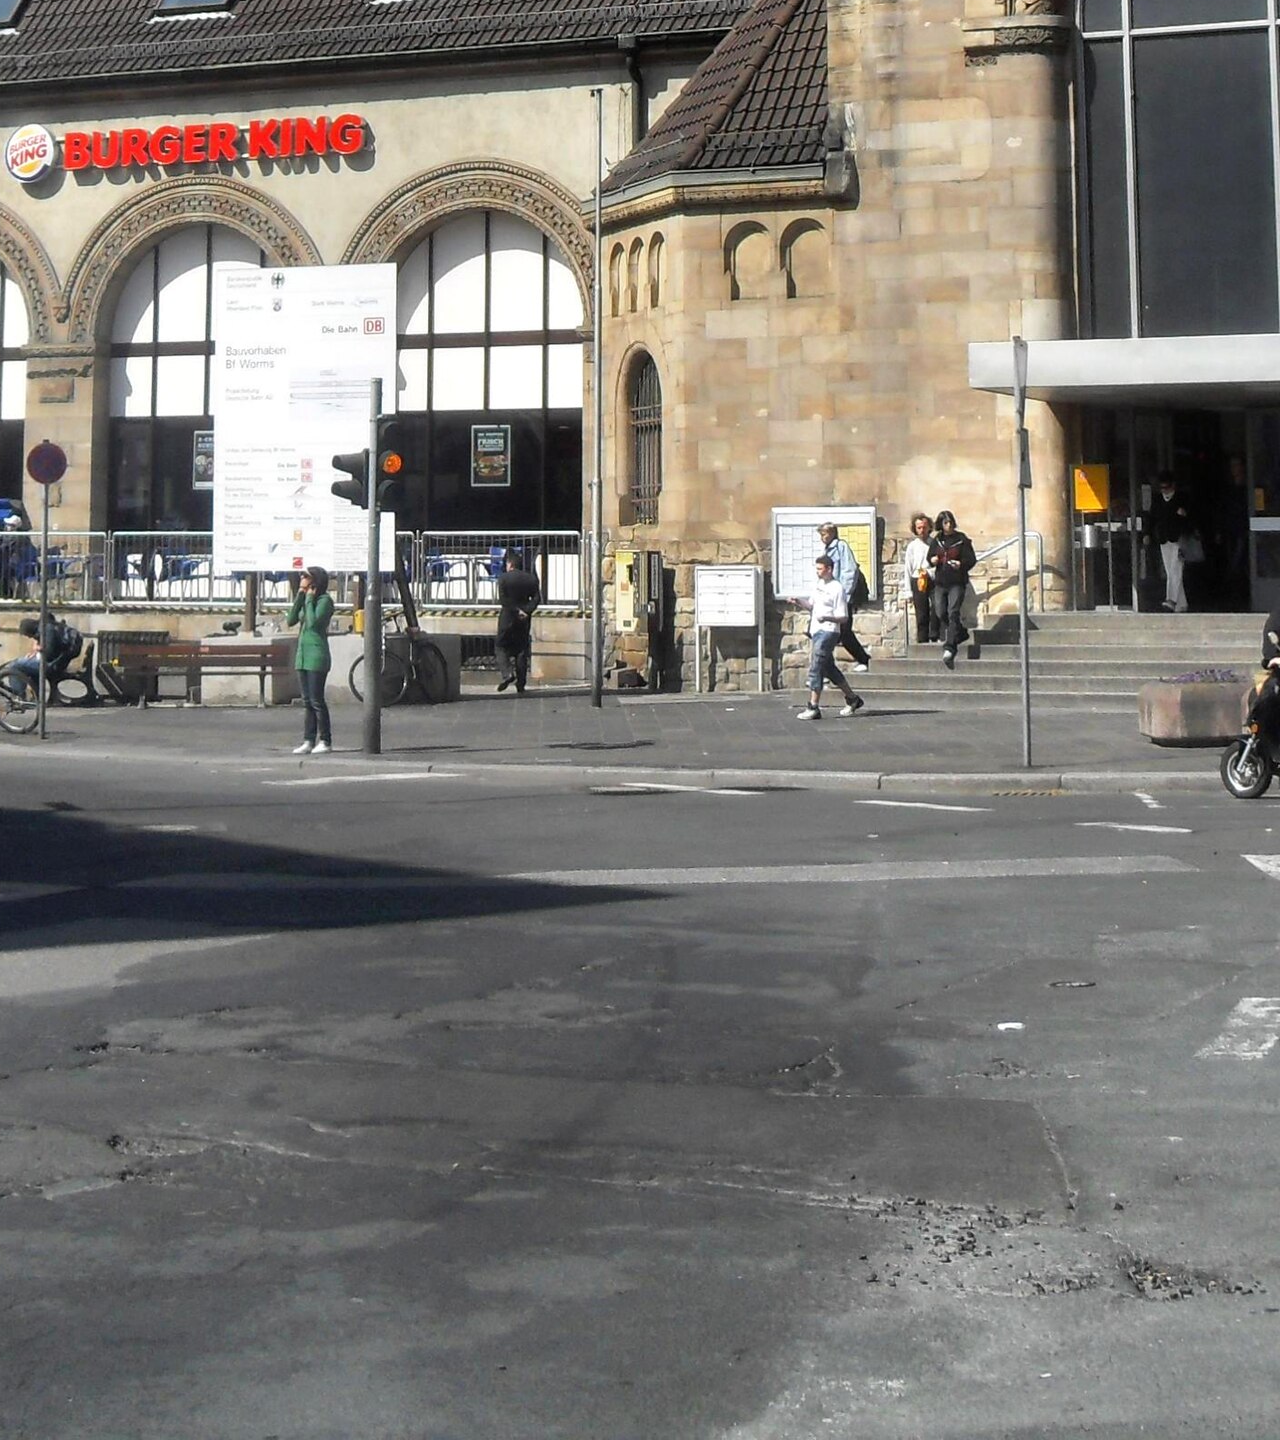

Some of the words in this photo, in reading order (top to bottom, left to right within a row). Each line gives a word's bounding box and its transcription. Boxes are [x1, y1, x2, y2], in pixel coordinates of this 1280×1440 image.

[10, 133, 47, 156] BURGER
[63, 121, 239, 171] BURGER
[248, 113, 365, 159] KING
[10, 143, 48, 170] KING
[338, 325, 358, 334] Bahn
[366, 320, 382, 333] DB
[225, 346, 287, 356] Bauvorhaben
[225, 359, 236, 369] Bf
[239, 359, 275, 369] Worms
